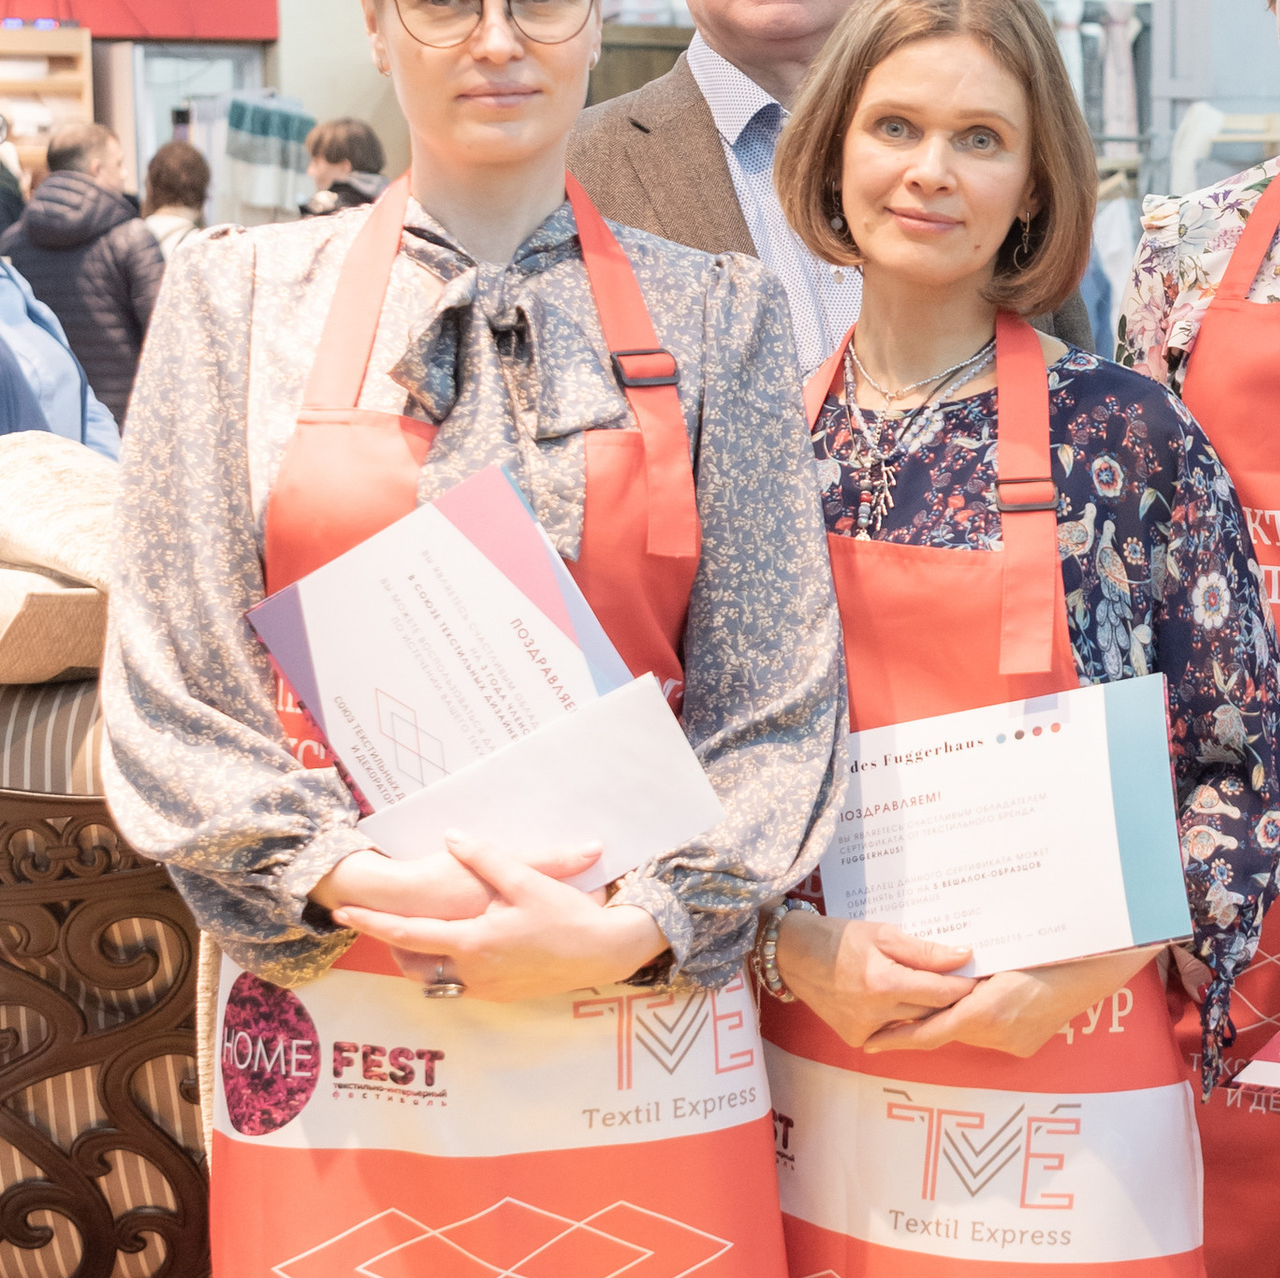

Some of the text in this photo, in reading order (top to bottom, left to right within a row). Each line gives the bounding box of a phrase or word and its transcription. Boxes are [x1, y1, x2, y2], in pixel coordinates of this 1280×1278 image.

[413, 583, 441, 620] СОЮЗЕ
[439, 621, 486, 691] ТЕКСТИЛЬНЫХ
[483, 695, 518, 740] ДИЗАЙНЕ
[510, 618, 577, 710] ПОЗДРАВЛЯЕ
[486, 672, 508, 702] ГОДА
[333, 695, 356, 724] СОЮЗ
[353, 723, 400, 792] ТЕКСТИЛЬНЫХ
[849, 738, 983, 774] des Fuggerhaus
[941, 860, 1042, 888] ВЕШАЛОК-ОБРАЗЦОВ
[223, 1027, 445, 1087] HOME FEST
[582, 1086, 757, 1130] Textil Express
[889, 1209, 1073, 1249] Textil Express
